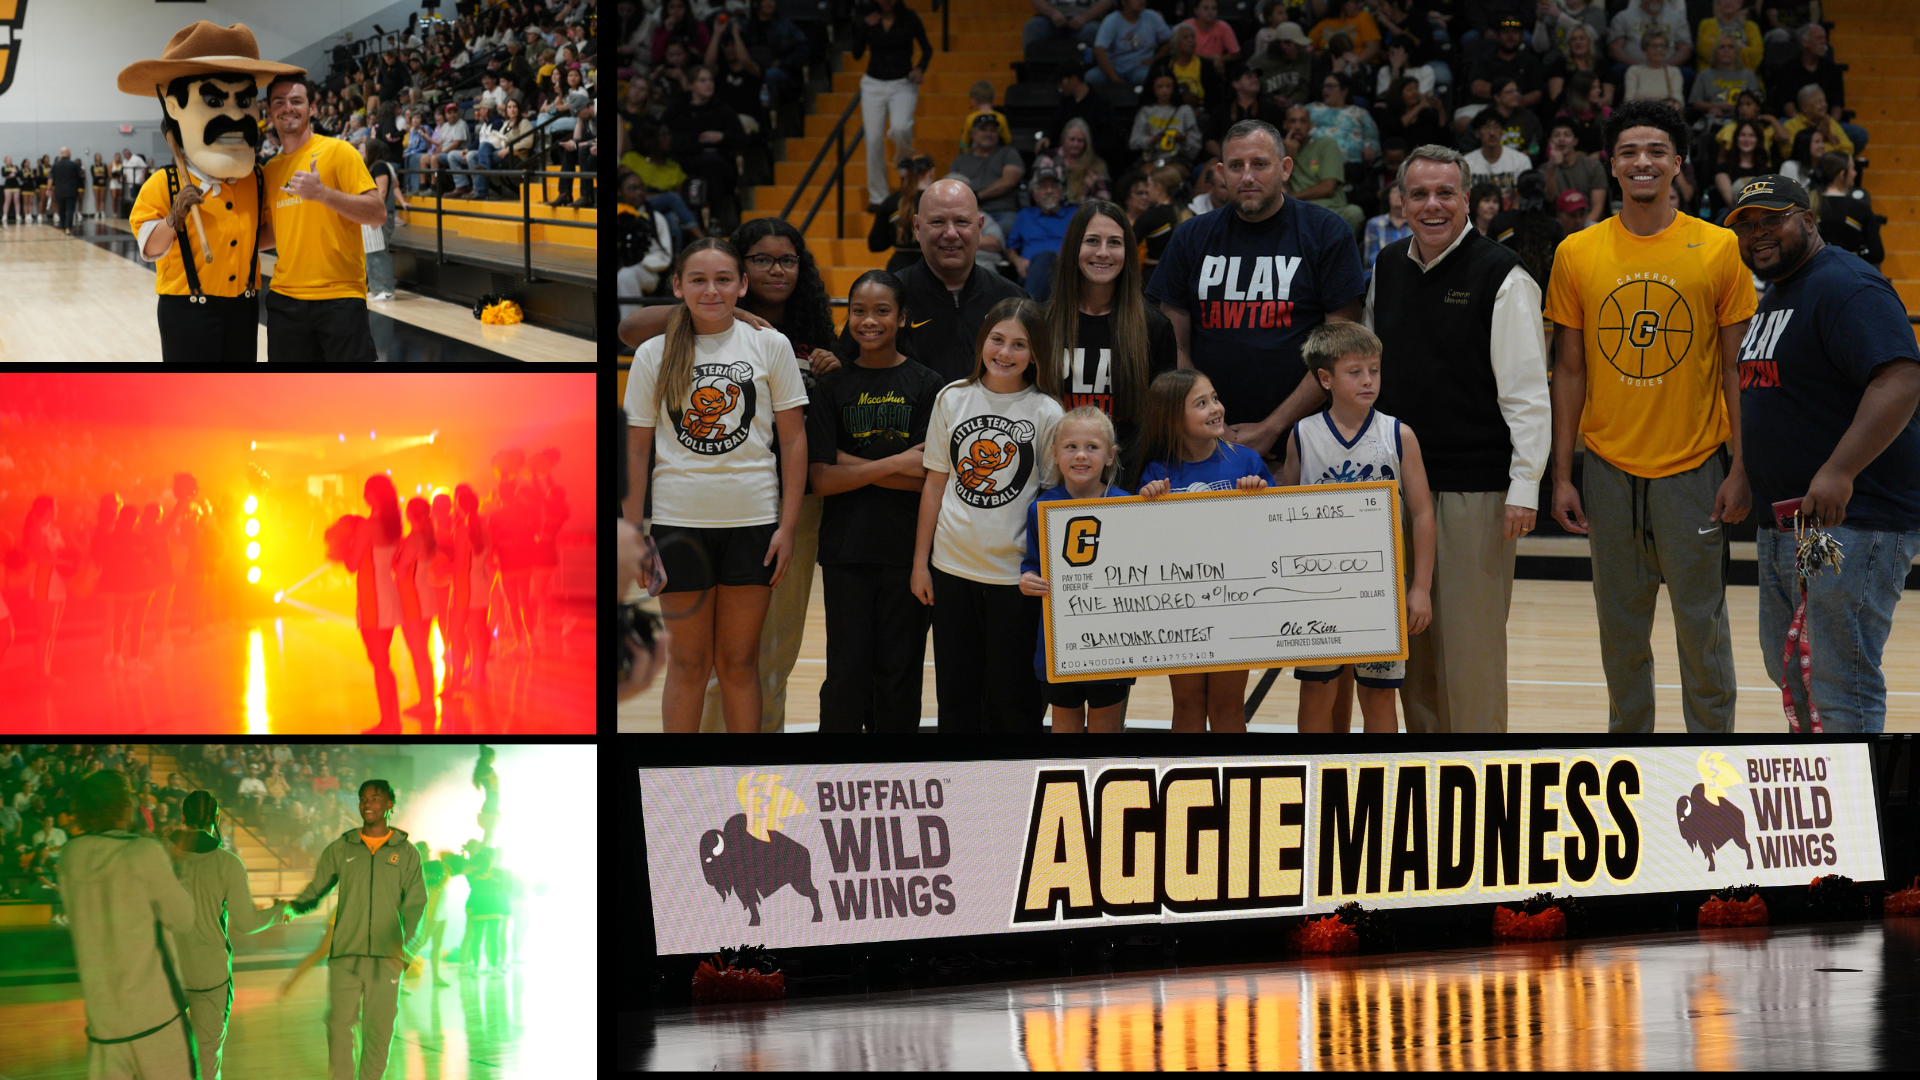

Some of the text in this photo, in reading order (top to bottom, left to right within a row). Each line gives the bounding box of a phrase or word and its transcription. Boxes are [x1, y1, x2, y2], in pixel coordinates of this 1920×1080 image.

[1198, 254, 1303, 301] PLAY
[1617, 272, 1677, 286] CAMERON
[1444, 296, 1469, 306] University
[1448, 288, 1470, 298] Cameron
[1200, 301, 1294, 329] LAWTON
[1736, 308, 1795, 362] PLAY
[1620, 374, 1663, 387] AGGIES
[857, 390, 906, 406] Macarthur
[842, 404, 876, 434] LADY
[679, 427, 749, 453] VOLLEYBALL
[953, 417, 983, 444] LITTLE
[1364, 498, 1377, 506] 16
[1268, 514, 1283, 522] DATE
[1104, 562, 1225, 587] PLAY LAWTON
[1271, 560, 1279, 574] $
[1293, 556, 1368, 575] 500.00
[1062, 572, 1094, 582] PAY TO THE
[1062, 583, 1090, 591] ORDER OF
[1359, 590, 1386, 599] DOLLARS
[1068, 594, 1107, 616] FIVE
[1113, 592, 1196, 613] HUNDRED
[1157, 626, 1215, 643] CONTEST
[1280, 620, 1338, 636] Ole Kim
[1065, 642, 1077, 651] FOR
[1276, 637, 1342, 648] AUTHORIZED SIGNATURE
[1746, 756, 1827, 783] BUFFALO
[816, 778, 944, 812] BUFFALO
[1749, 786, 1833, 831] WILD
[819, 815, 951, 873] WILD
[1012, 759, 1641, 924] AGGIE MADNESS
[1756, 833, 1838, 869] WINGS
[828, 874, 956, 921] WINGS
